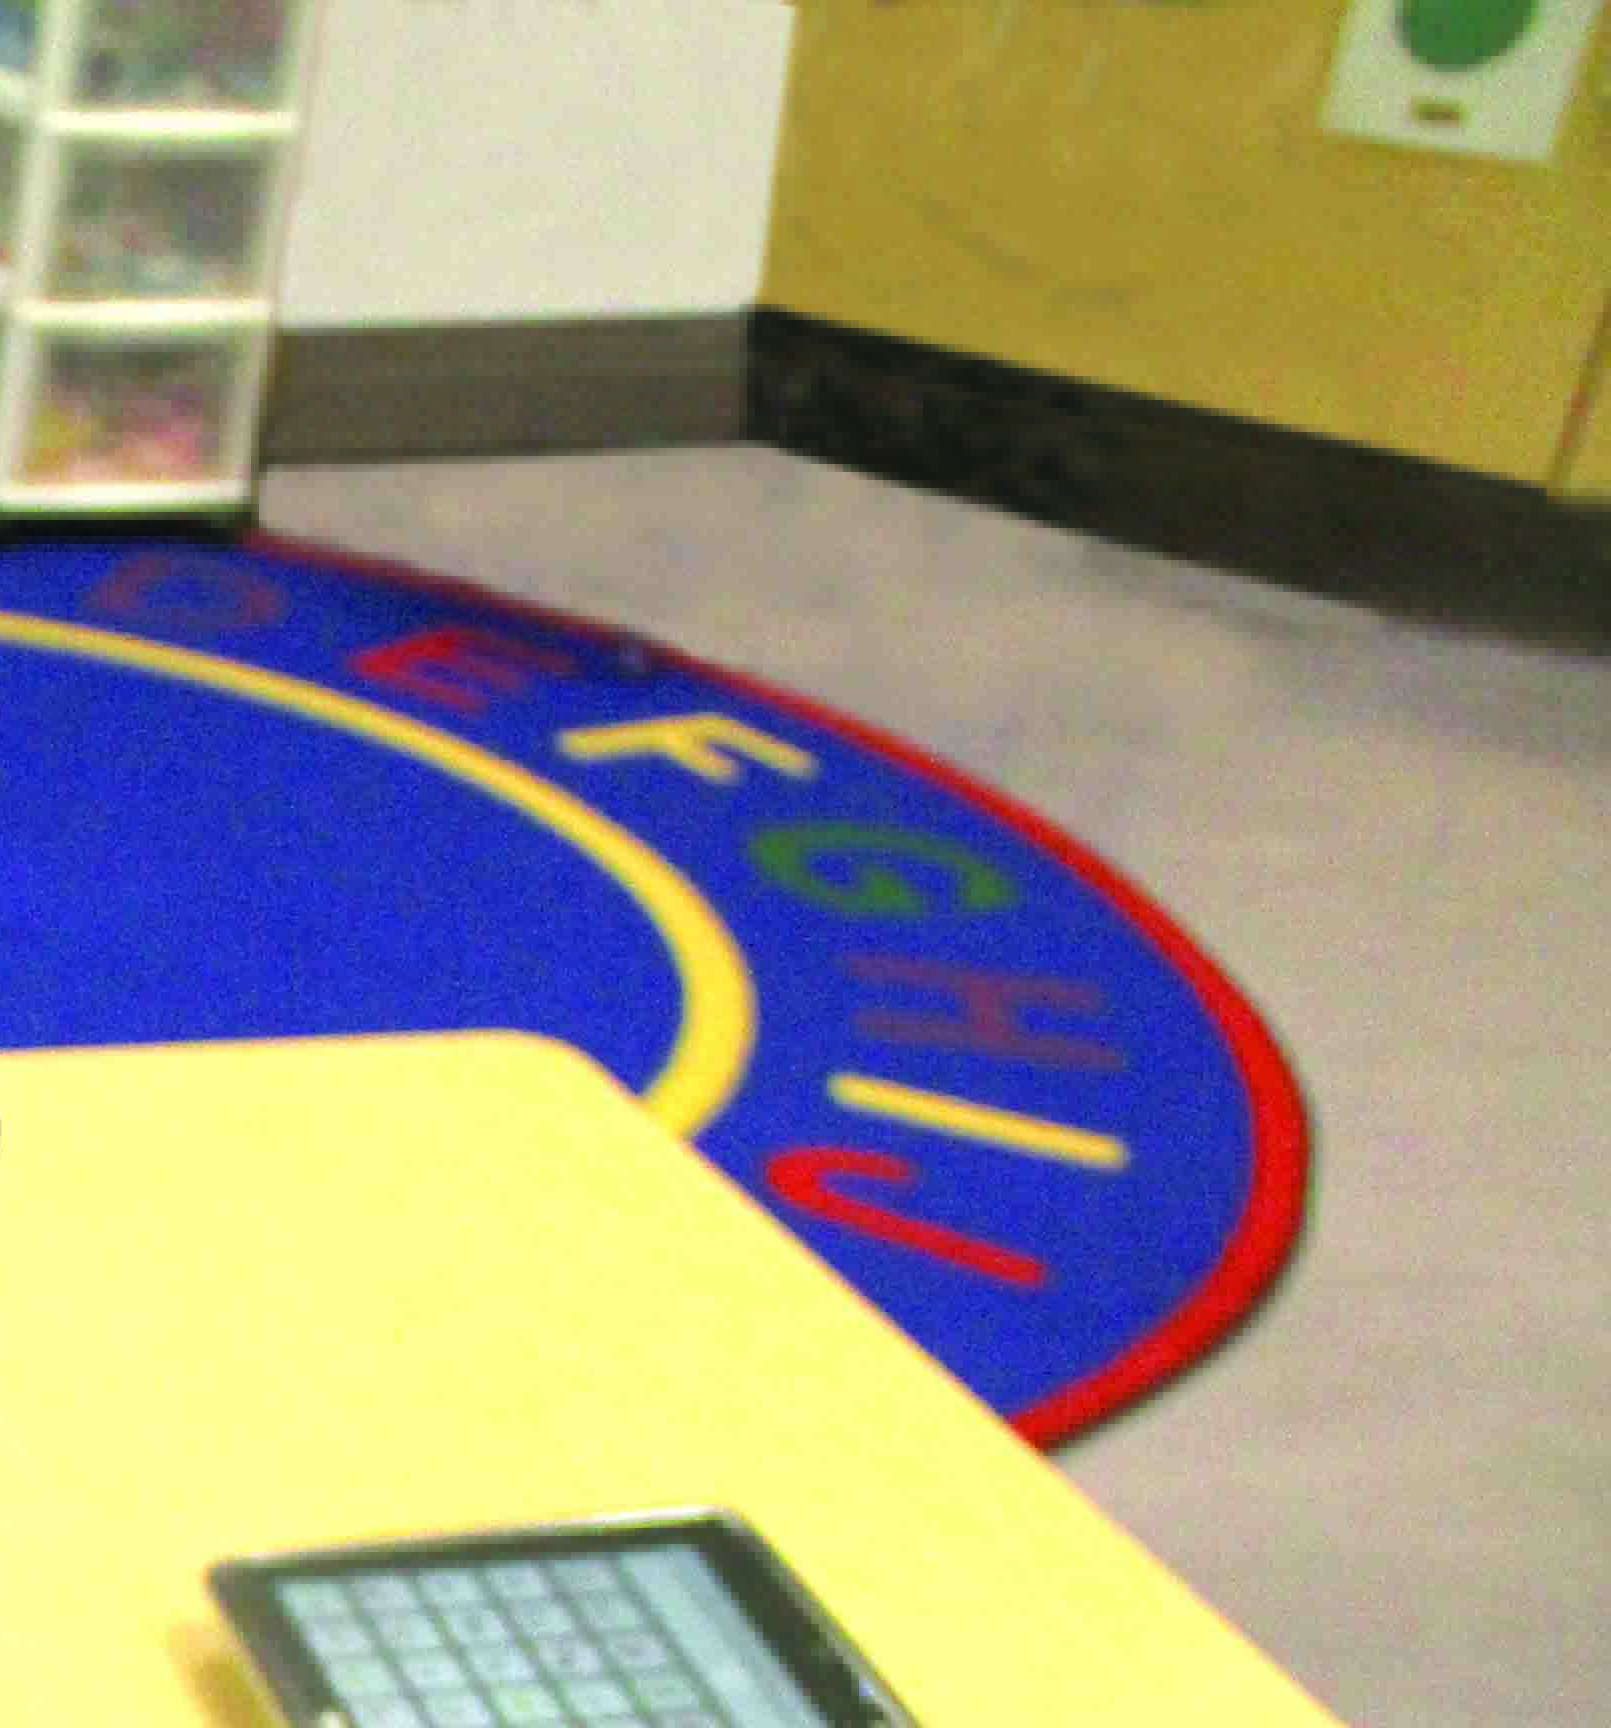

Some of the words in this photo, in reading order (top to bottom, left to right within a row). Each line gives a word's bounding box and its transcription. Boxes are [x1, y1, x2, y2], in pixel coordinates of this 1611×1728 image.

[345, 626, 579, 715] E
[557, 712, 819, 788] F
[743, 822, 1019, 915] G
[841, 952, 1127, 1070] H
[827, 1072, 1129, 1170] I
[764, 1145, 1051, 1288] J
